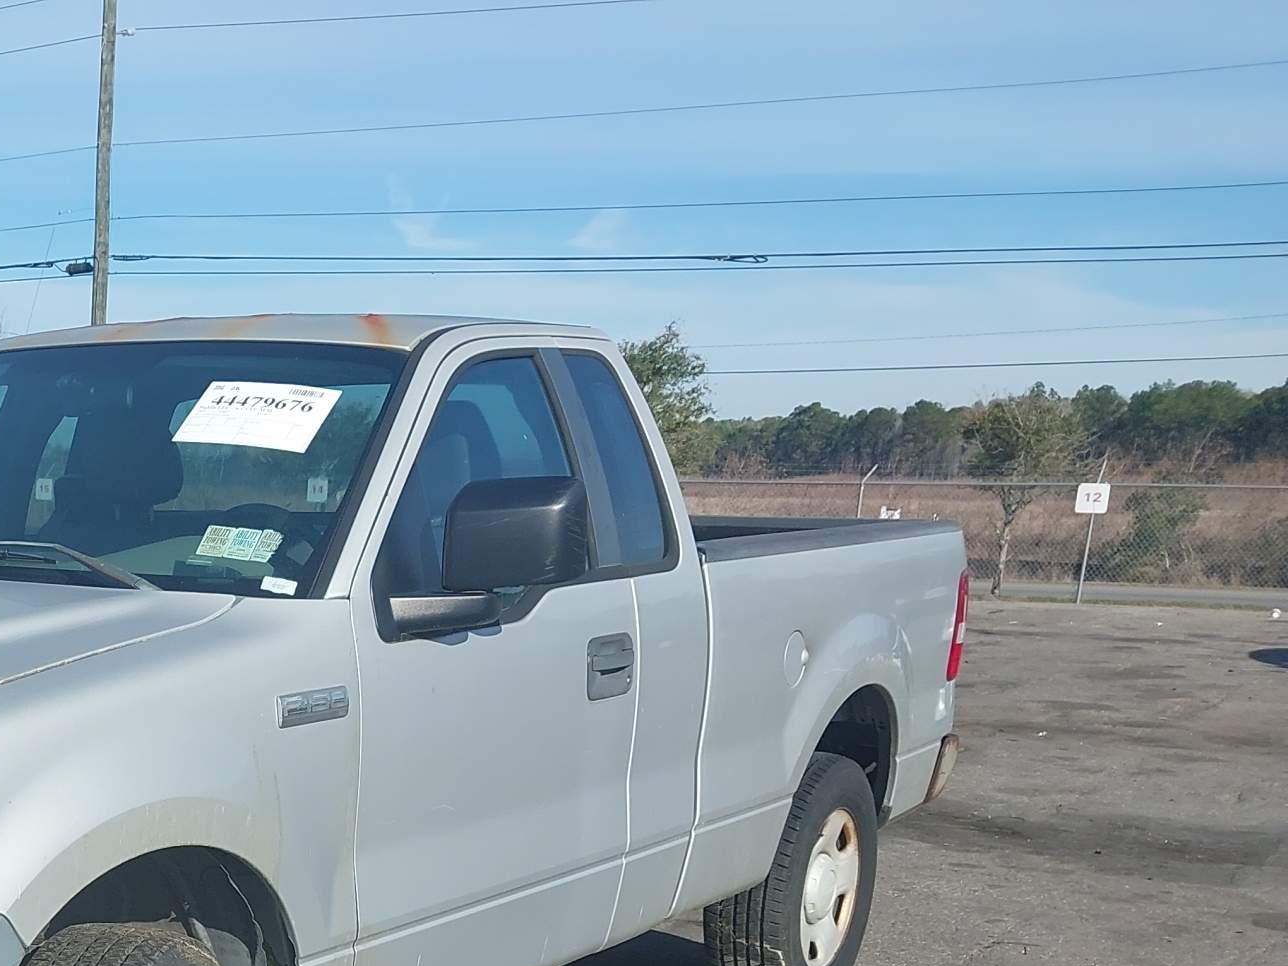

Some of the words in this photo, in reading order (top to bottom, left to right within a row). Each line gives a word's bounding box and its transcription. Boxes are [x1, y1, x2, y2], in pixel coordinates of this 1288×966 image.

[211, 395, 316, 413] 44479676
[1085, 492, 1102, 503] 12
[233, 529, 258, 540] ABILITY
[203, 536, 228, 546] TOWING
[230, 538, 255, 549] TOWING
